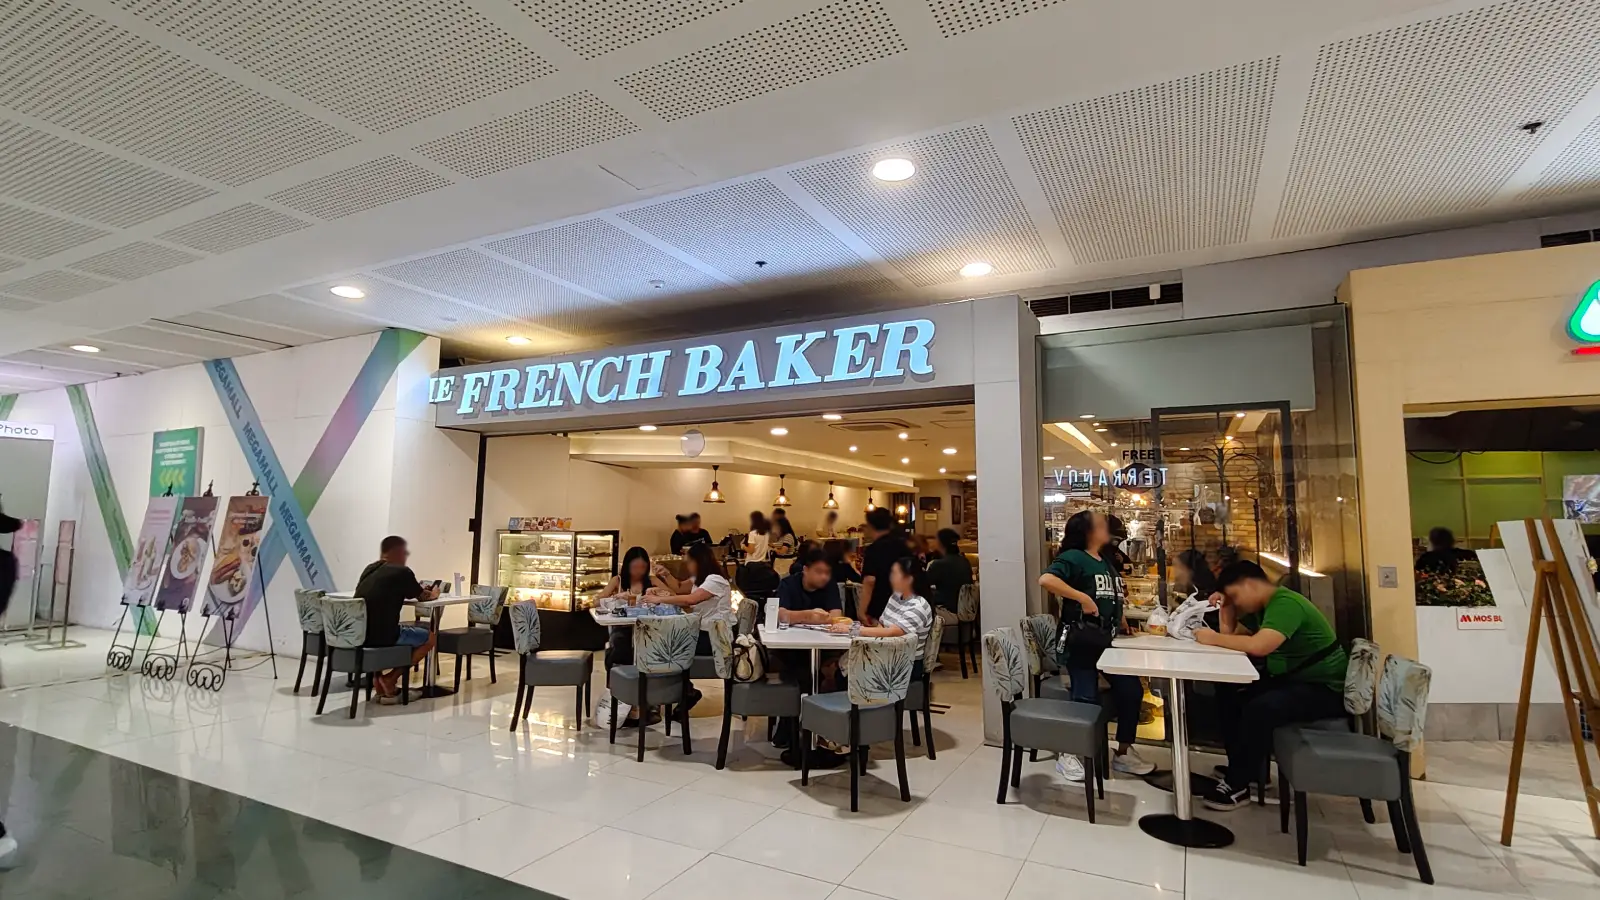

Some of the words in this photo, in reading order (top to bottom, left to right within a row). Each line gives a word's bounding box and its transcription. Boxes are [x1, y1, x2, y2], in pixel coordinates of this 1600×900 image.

[213, 360, 242, 419] EGAMALL
[457, 350, 671, 415] FRENCH
[678, 319, 935, 396] BAKER
[242, 421, 279, 497] MEGAMALL
[1122, 449, 1156, 460] FREE
[278, 500, 321, 585] MEGAMALL
